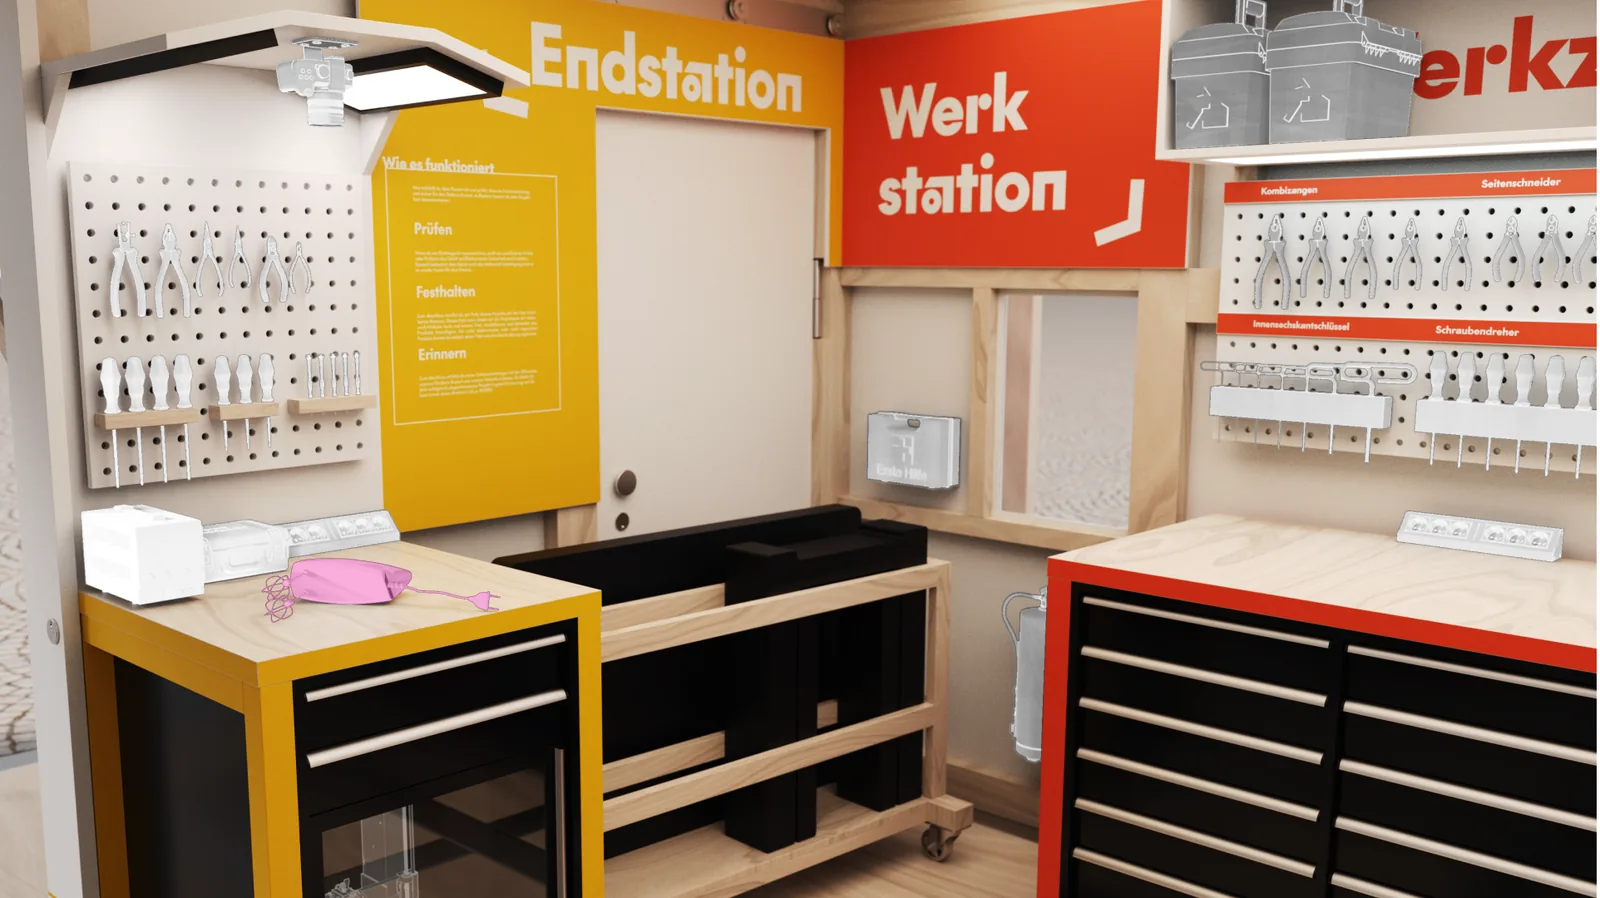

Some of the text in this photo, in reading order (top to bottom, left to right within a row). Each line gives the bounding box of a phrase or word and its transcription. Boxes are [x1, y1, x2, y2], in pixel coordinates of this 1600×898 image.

[1413, 15, 1597, 100] erkz
[530, 21, 802, 112] Endstation
[879, 71, 1029, 141] Werk
[382, 155, 495, 174] Wie es funktioniert
[878, 152, 1067, 216] station
[1481, 177, 1561, 189] Seitenschneider
[1260, 184, 1318, 197] Kombizangen
[413, 222, 453, 236] Prüfen
[416, 285, 476, 299] Festhalten
[1252, 319, 1350, 332] Innensechskantschlüssel
[1435, 325, 1520, 338] Schraubendreher
[418, 347, 467, 361] Erinnern
